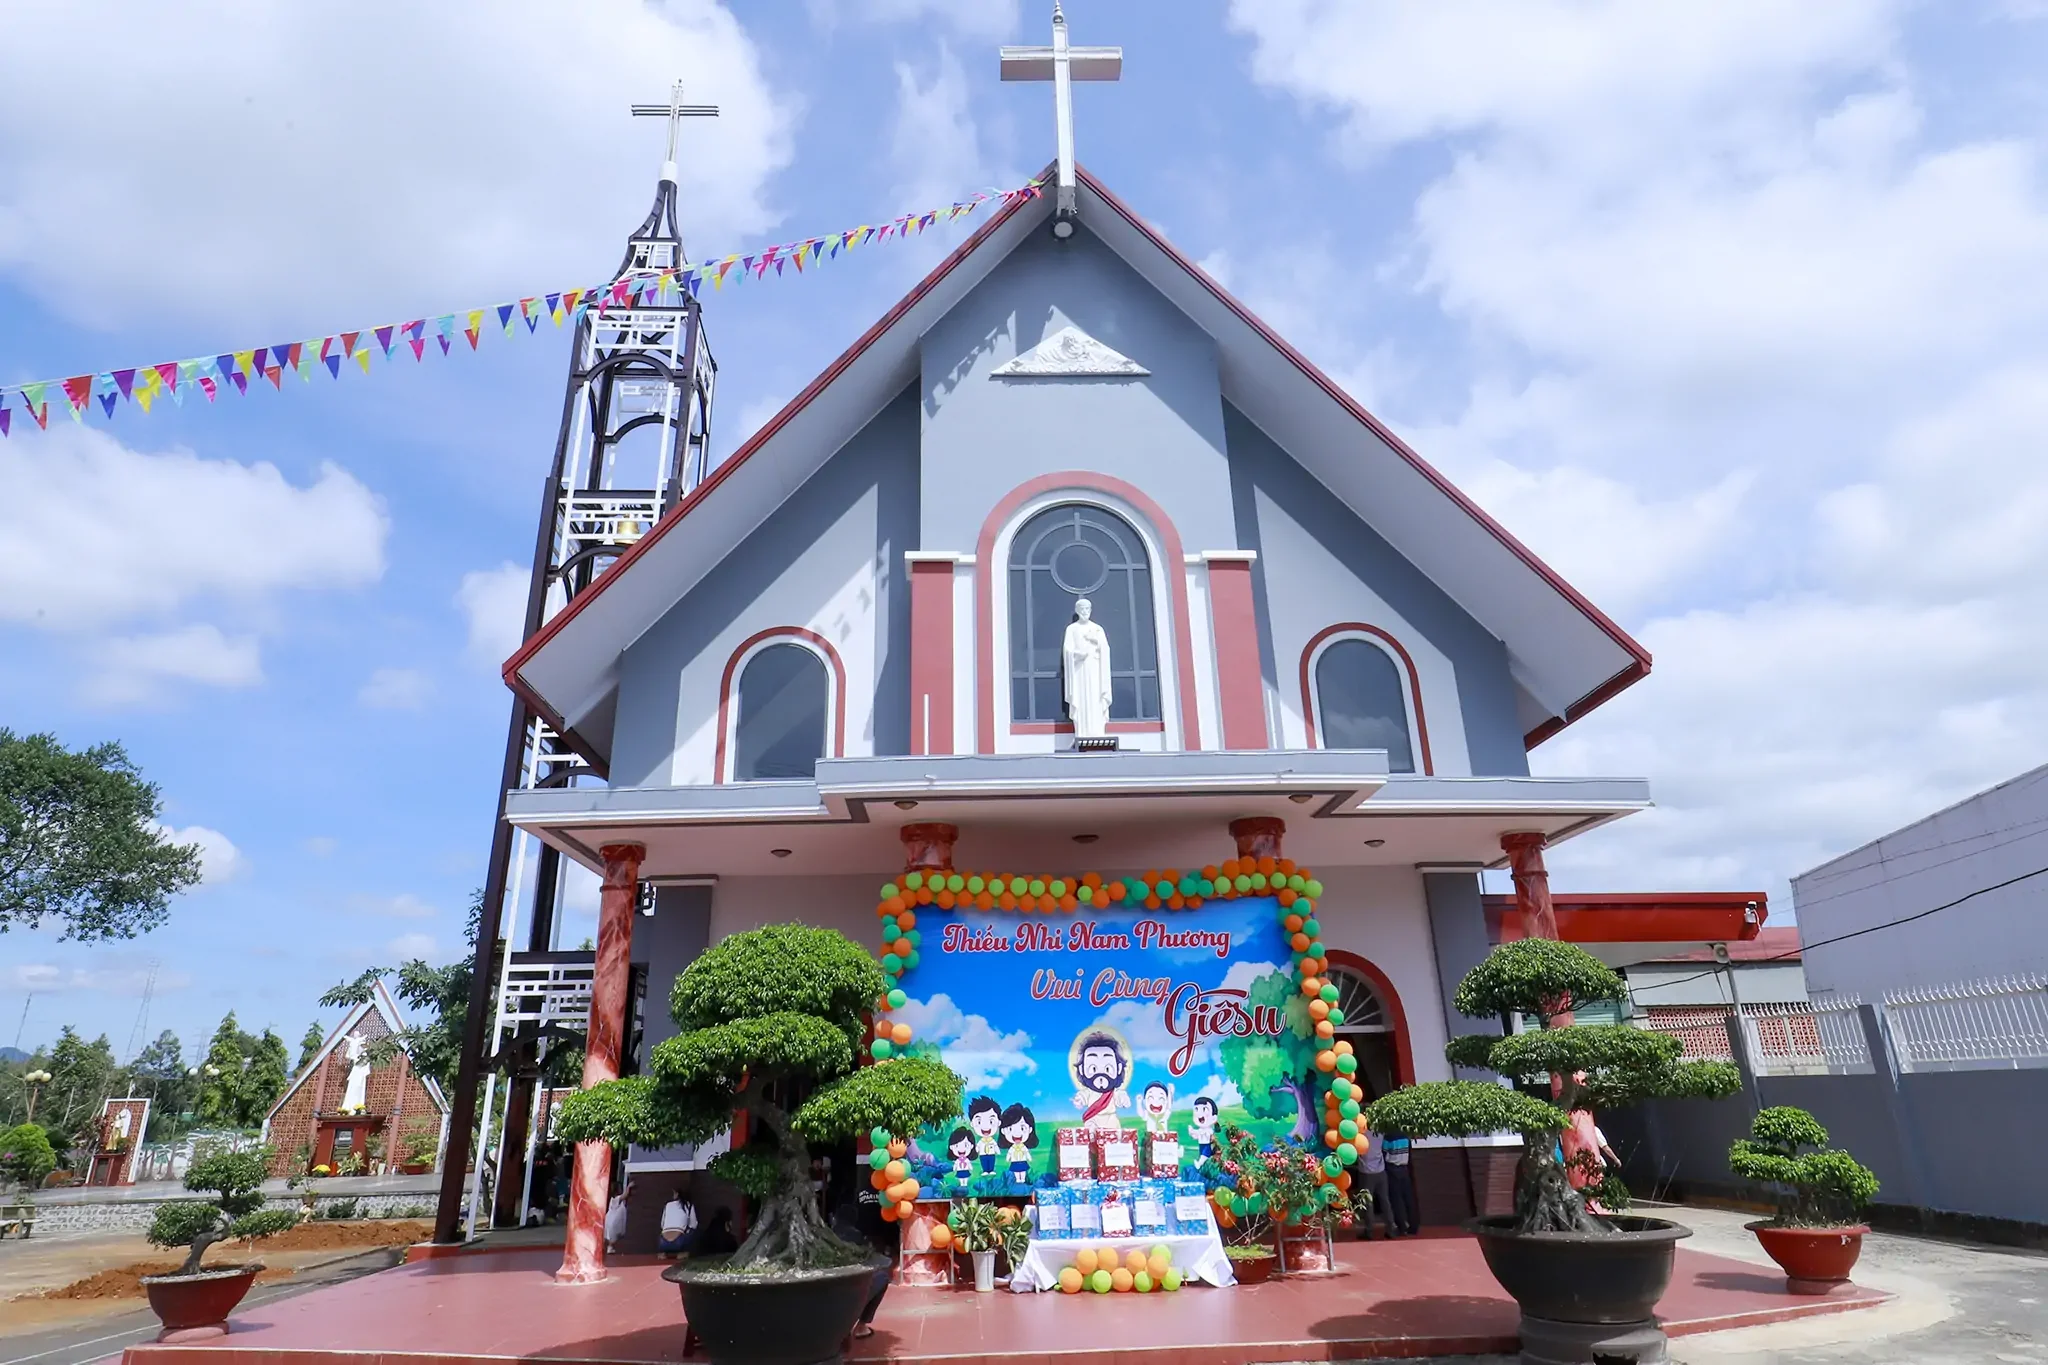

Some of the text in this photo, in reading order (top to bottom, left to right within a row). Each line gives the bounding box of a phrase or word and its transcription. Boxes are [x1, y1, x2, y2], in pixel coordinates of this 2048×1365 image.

[943, 920, 1231, 958] Thiếu Nhi Nam Phương
[1031, 967, 1171, 1006] Vui Cùng
[1164, 981, 1287, 1077] Giêsu
